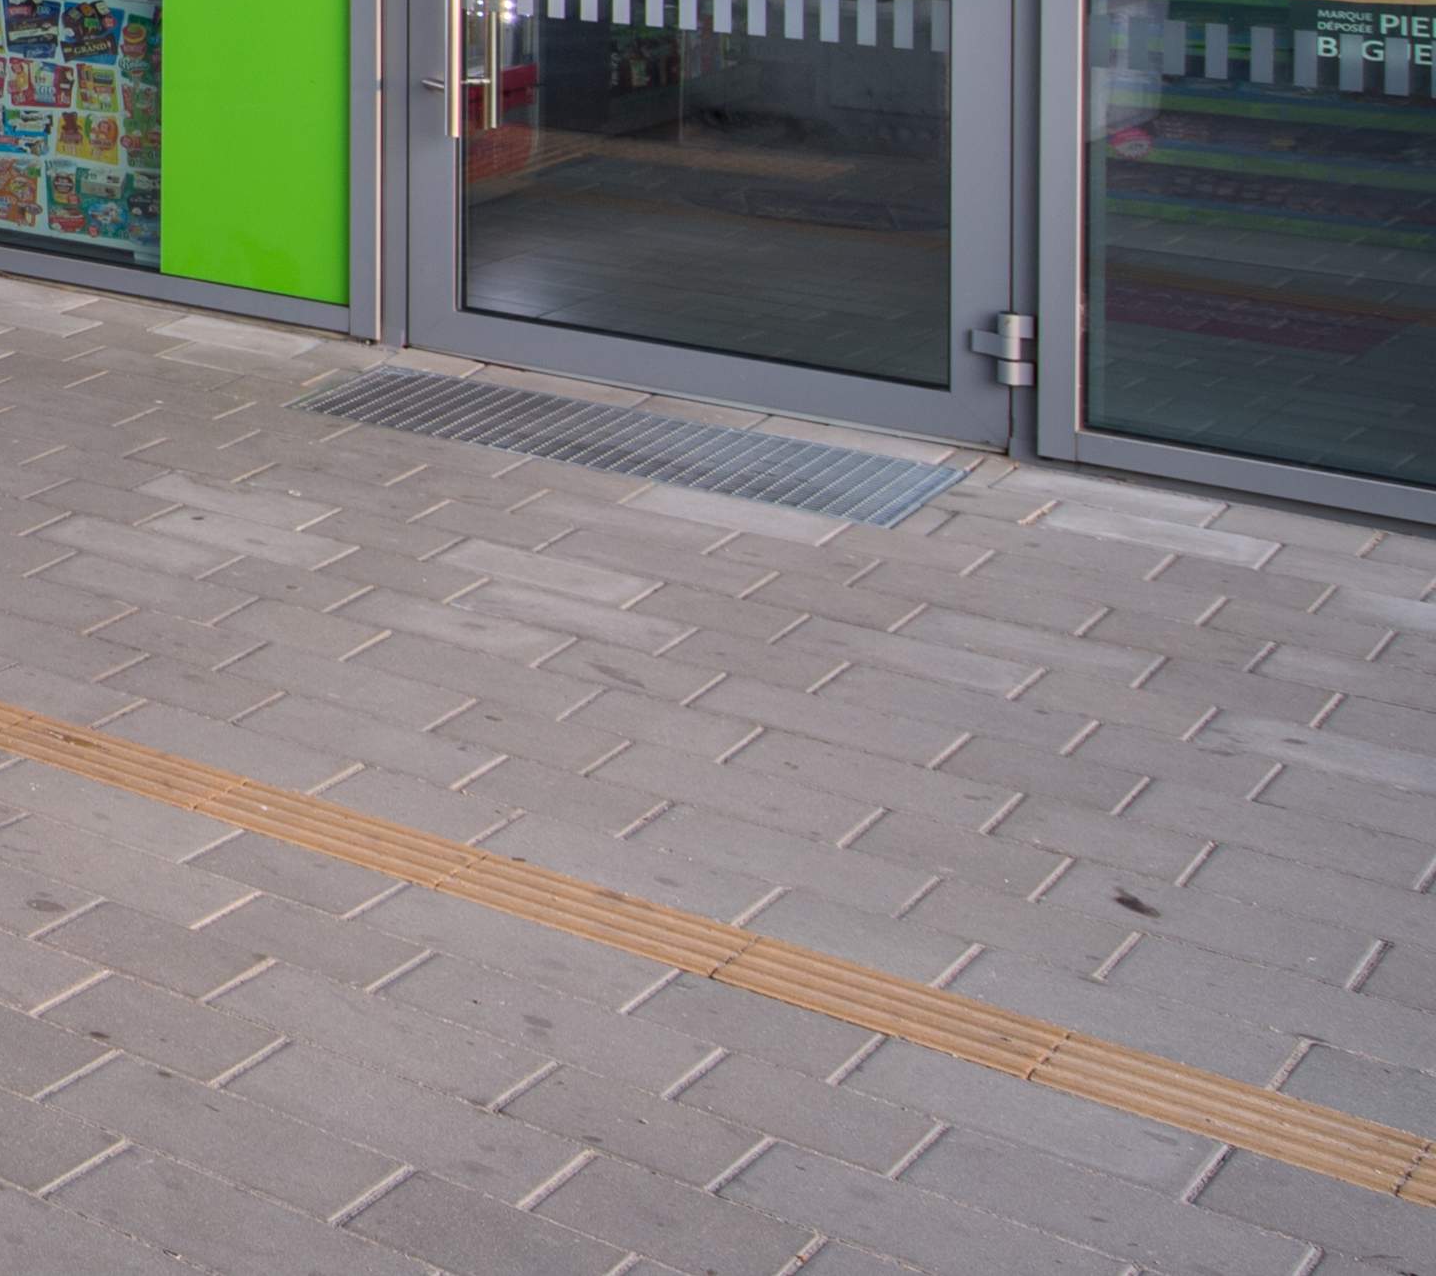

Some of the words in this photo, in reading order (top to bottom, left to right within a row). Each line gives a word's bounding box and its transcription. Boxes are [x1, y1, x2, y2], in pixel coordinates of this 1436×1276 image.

[1317, 9, 1373, 23] MARQUE
[1316, 20, 1374, 34] DÉPOSÉE
[1379, 12, 1436, 39] PIE
